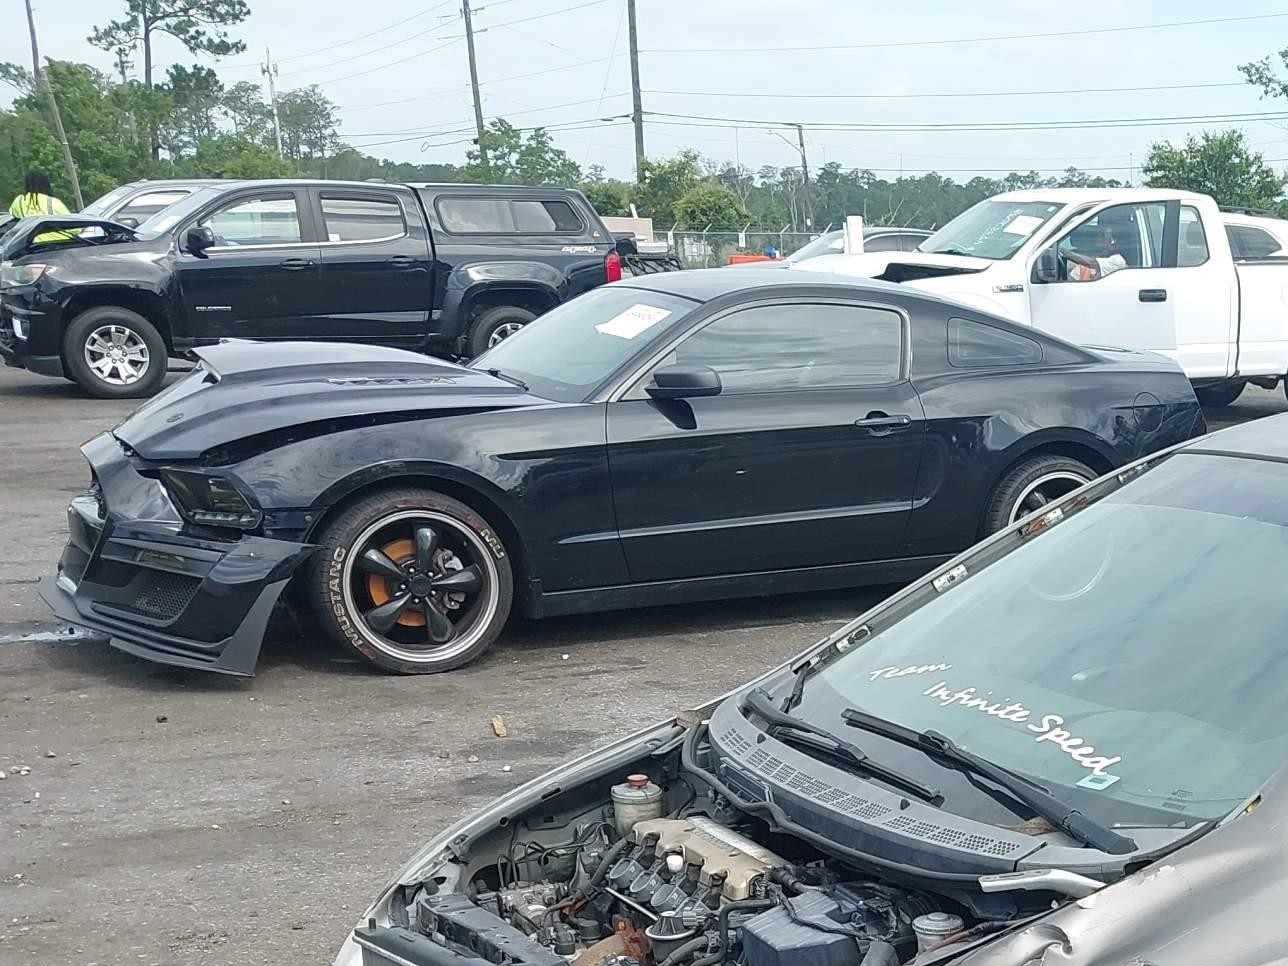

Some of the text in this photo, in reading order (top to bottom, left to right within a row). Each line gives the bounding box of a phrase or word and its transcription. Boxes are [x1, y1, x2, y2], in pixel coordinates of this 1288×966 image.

[328, 545, 364, 648] MUSTANG
[922, 680, 1122, 776] Infinite Speed
